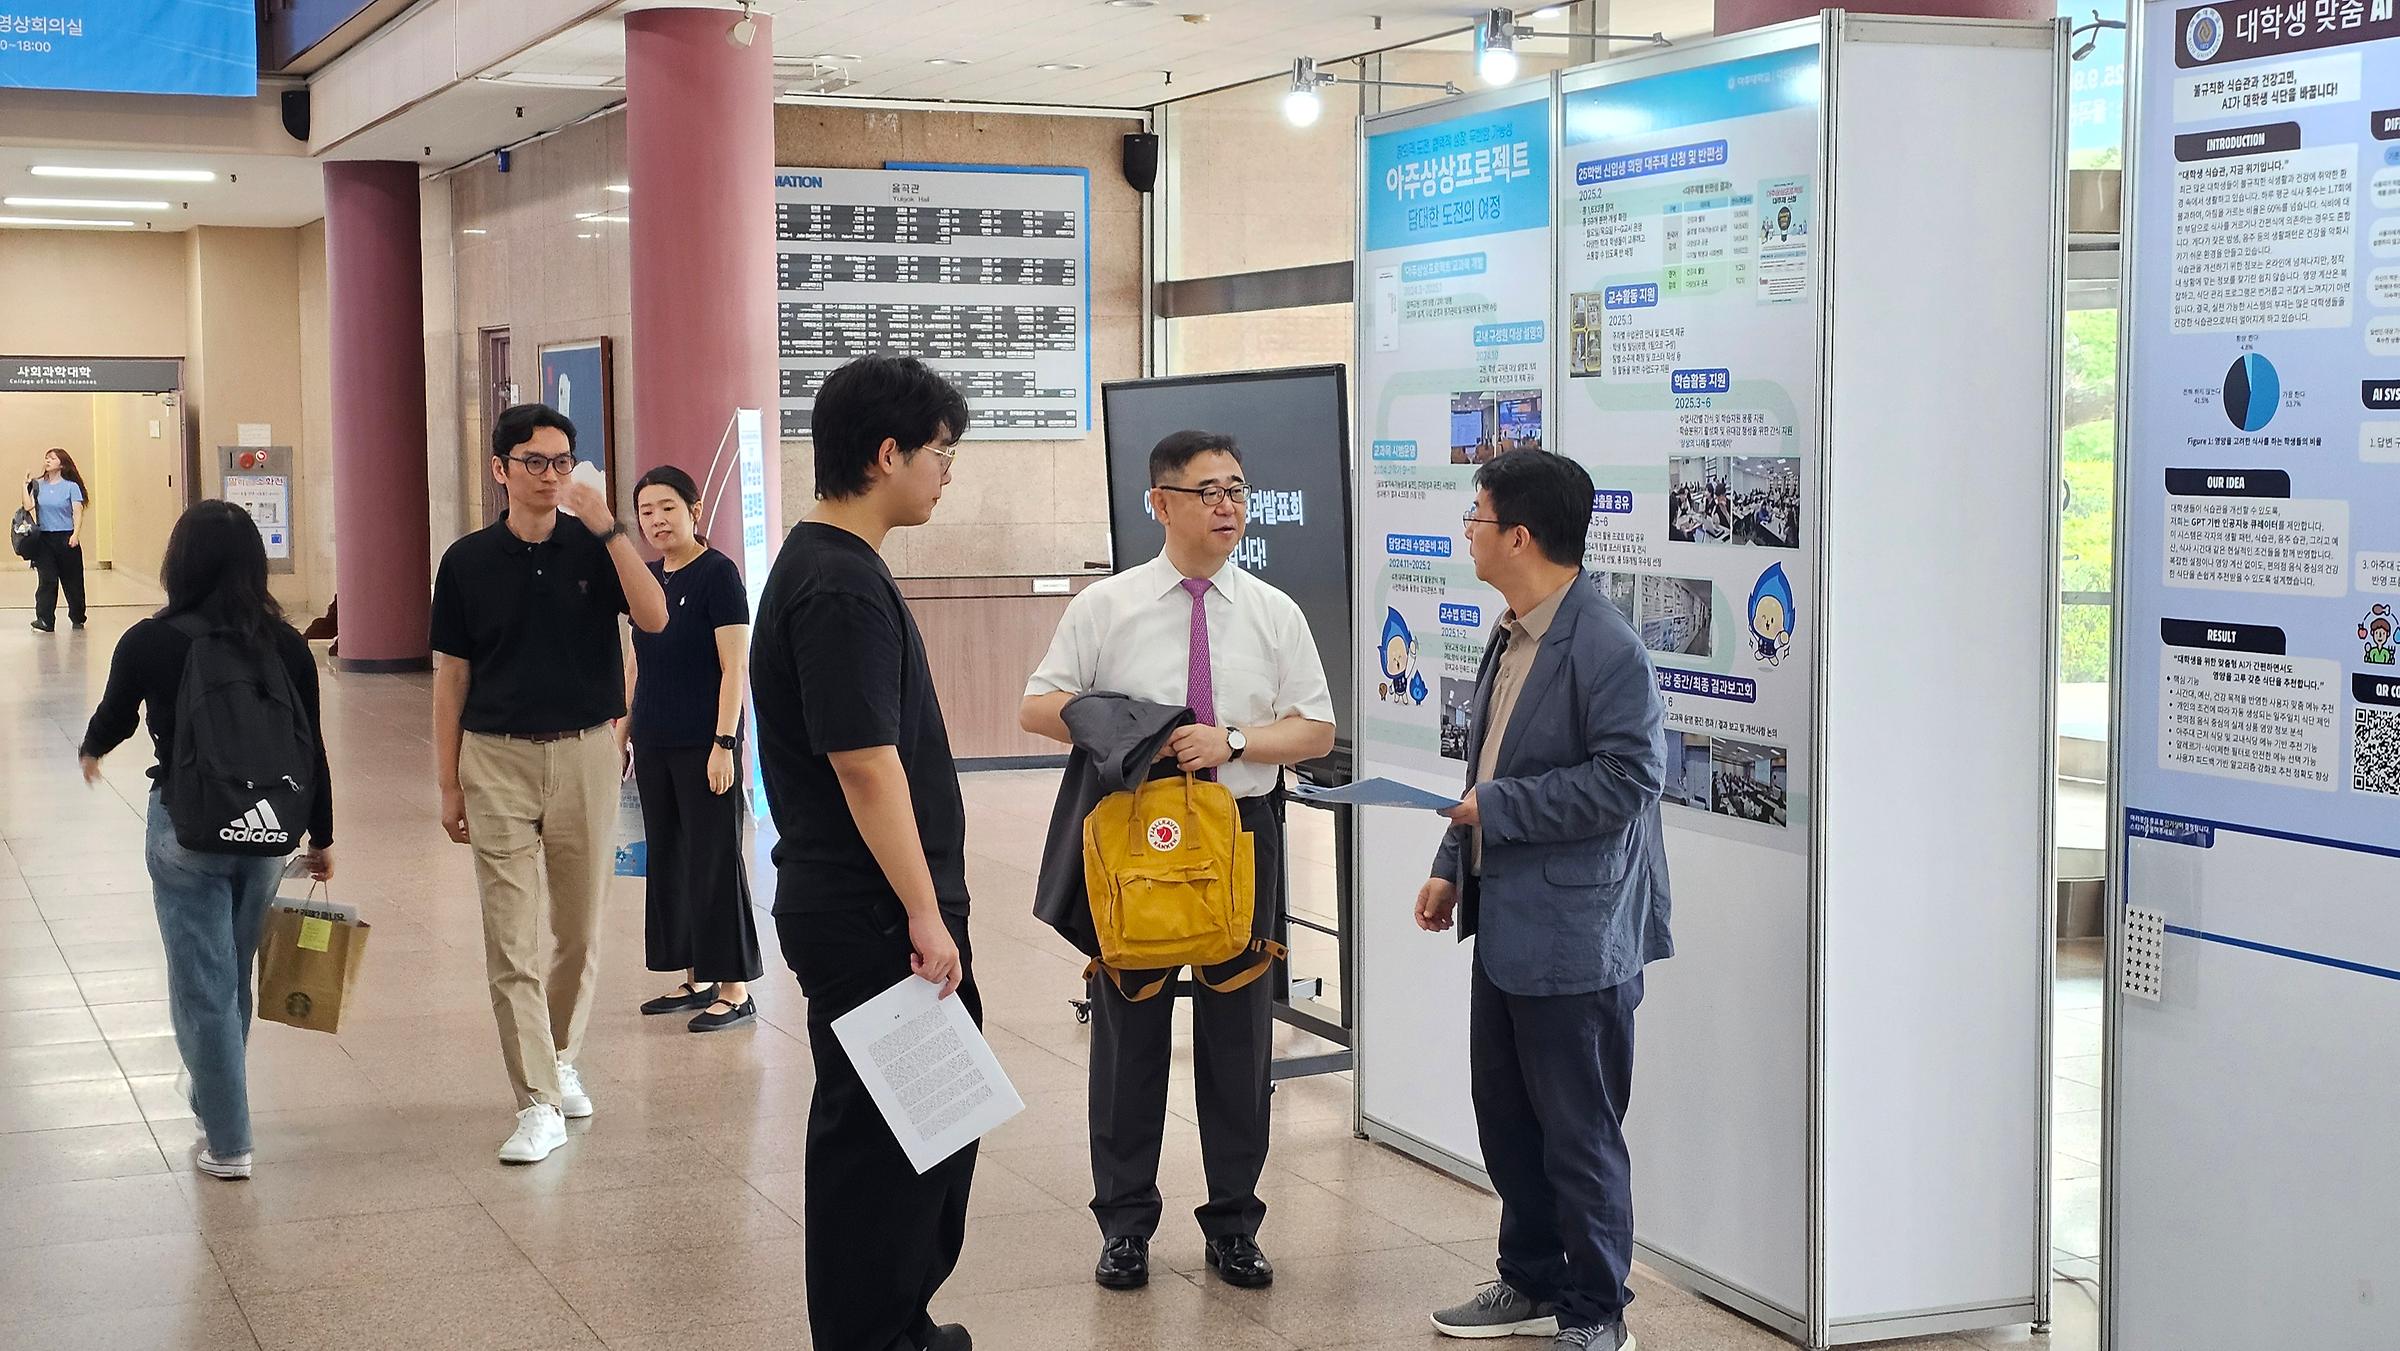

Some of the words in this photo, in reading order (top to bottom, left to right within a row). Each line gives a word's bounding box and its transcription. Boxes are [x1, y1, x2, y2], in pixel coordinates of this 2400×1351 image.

[2236, 3, 2306, 44] 대학생
[2315, 0, 2365, 33] 맞춤
[2369, 0, 2394, 22] AI
[2194, 80, 2224, 99] 불규칙한
[2228, 74, 2259, 94] 식습관과
[2262, 69, 2298, 89] 건강고민,
[2222, 96, 2241, 112] AI가
[2243, 92, 2268, 109] 대학생
[2270, 88, 2296, 105] 식단을
[2300, 81, 2338, 101] 바꿉니다!
[2206, 132, 2266, 152] INTRODUCTION
[1578, 164, 1602, 182] 25학번
[1604, 160, 1626, 178] 신입생
[1628, 157, 1643, 174] 희망
[1644, 153, 1668, 172] 대주제
[1670, 150, 1686, 168] 신청
[1688, 149, 1696, 165] 및
[1698, 144, 1724, 163] 반편성
[1386, 139, 1530, 204] 아주상상프로젝트
[2205, 166, 2228, 179] 식습관,
[2230, 164, 2244, 176] 지금
[892, 183, 920, 194] 율곡관
[1578, 188, 1602, 202] 2025.2
[1409, 204, 1439, 231] 담대한
[1442, 199, 1474, 226] 도전의
[1478, 194, 1501, 221] 여정
[1608, 289, 1638, 306] 교수활동
[1640, 287, 1655, 304] 지원
[1608, 313, 1632, 327] 2025.3
[1476, 330, 1488, 343] 교내
[1490, 328, 1508, 342] 구성원
[1510, 327, 1521, 341] 대상
[1522, 326, 1542, 340] 설명회
[17, 366, 92, 378] 사회과학대학
[9, 378, 34, 386] College
[1674, 373, 1707, 390] 학습활동
[1708, 372, 1726, 389] 지원
[2372, 388, 2383, 400] AI
[1675, 397, 1711, 409] 2025.3~6
[2187, 437, 2206, 446] Figure
[2208, 437, 2214, 446] 1:
[2215, 437, 2232, 446] 영양을
[2233, 437, 2250, 447] 고려한
[2252, 437, 2270, 447] 식사를
[2271, 437, 2282, 447] 하는
[2284, 437, 2308, 447] 학생들의
[2310, 437, 2322, 447] 비율
[2377, 437, 2393, 448] 답변
[2207, 475, 2225, 489] OUR
[2226, 476, 2246, 490] IDEA
[1614, 495, 1629, 509] 공유
[2170, 502, 2201, 513] 대학생들이
[2203, 504, 2228, 514] 식습관을
[2230, 505, 2249, 515] 개선할
[2251, 506, 2257, 516] 수
[2258, 506, 2281, 517] 있도록,
[2170, 517, 2190, 527] 저희는
[2191, 518, 2206, 528] GPT
[2208, 518, 2221, 528] 기반
[2222, 518, 2250, 529] 인공지능
[2251, 519, 2286, 531] 큐레이터를
[2287, 520, 2324, 532] 제안합니다.
[1388, 538, 1412, 551] 담당교원
[1413, 539, 1437, 553] 수업준비
[1438, 540, 1450, 553] 지원
[2362, 559, 2369, 570] 3.
[2370, 560, 2395, 571] 아주대
[2371, 575, 2387, 586] 반영
[1441, 607, 1459, 622] 교수법
[1460, 608, 1478, 624] 워크숍
[2207, 628, 2237, 644] RESULT
[2203, 656, 2216, 667] 위한
[2218, 658, 2238, 669] 맞춤형
[2239, 659, 2252, 670] AI가
[2253, 661, 2294, 674] 간편하면서도
[1674, 674, 1710, 693] 중간/최종
[1711, 679, 1753, 699] 결과보고회
[2173, 675, 2185, 685] 핵심
[2187, 677, 2200, 686] 기능
[2212, 671, 2232, 682] 영양을
[2234, 673, 2246, 684] 고루
[2248, 674, 2260, 685] 갖춘
[2263, 676, 2282, 687] 식단을
[2375, 683, 2389, 697] QR
[2176, 688, 2197, 700] 시간대,
[2198, 690, 2212, 701] 예산,
[2214, 692, 2226, 703] 건강
[2228, 693, 2246, 705] 목적을
[2248, 695, 2268, 708] 반영한
[2270, 698, 2290, 710] 사용자
[2291, 700, 2304, 711] 맞춤
[2306, 701, 2319, 713] 메뉴
[2320, 703, 2334, 715] 추천
[2175, 751, 2194, 763] 사용자
[2196, 754, 2214, 766] 피드백
[2215, 757, 2228, 768] 기반
[2230, 759, 2256, 772] 알고리즘
[2258, 762, 2276, 775] 강화로
[2278, 765, 2292, 777] 추천
[2294, 767, 2314, 780] 정확도
[2316, 770, 2330, 783] 향상
[219, 827, 289, 844] adidas
